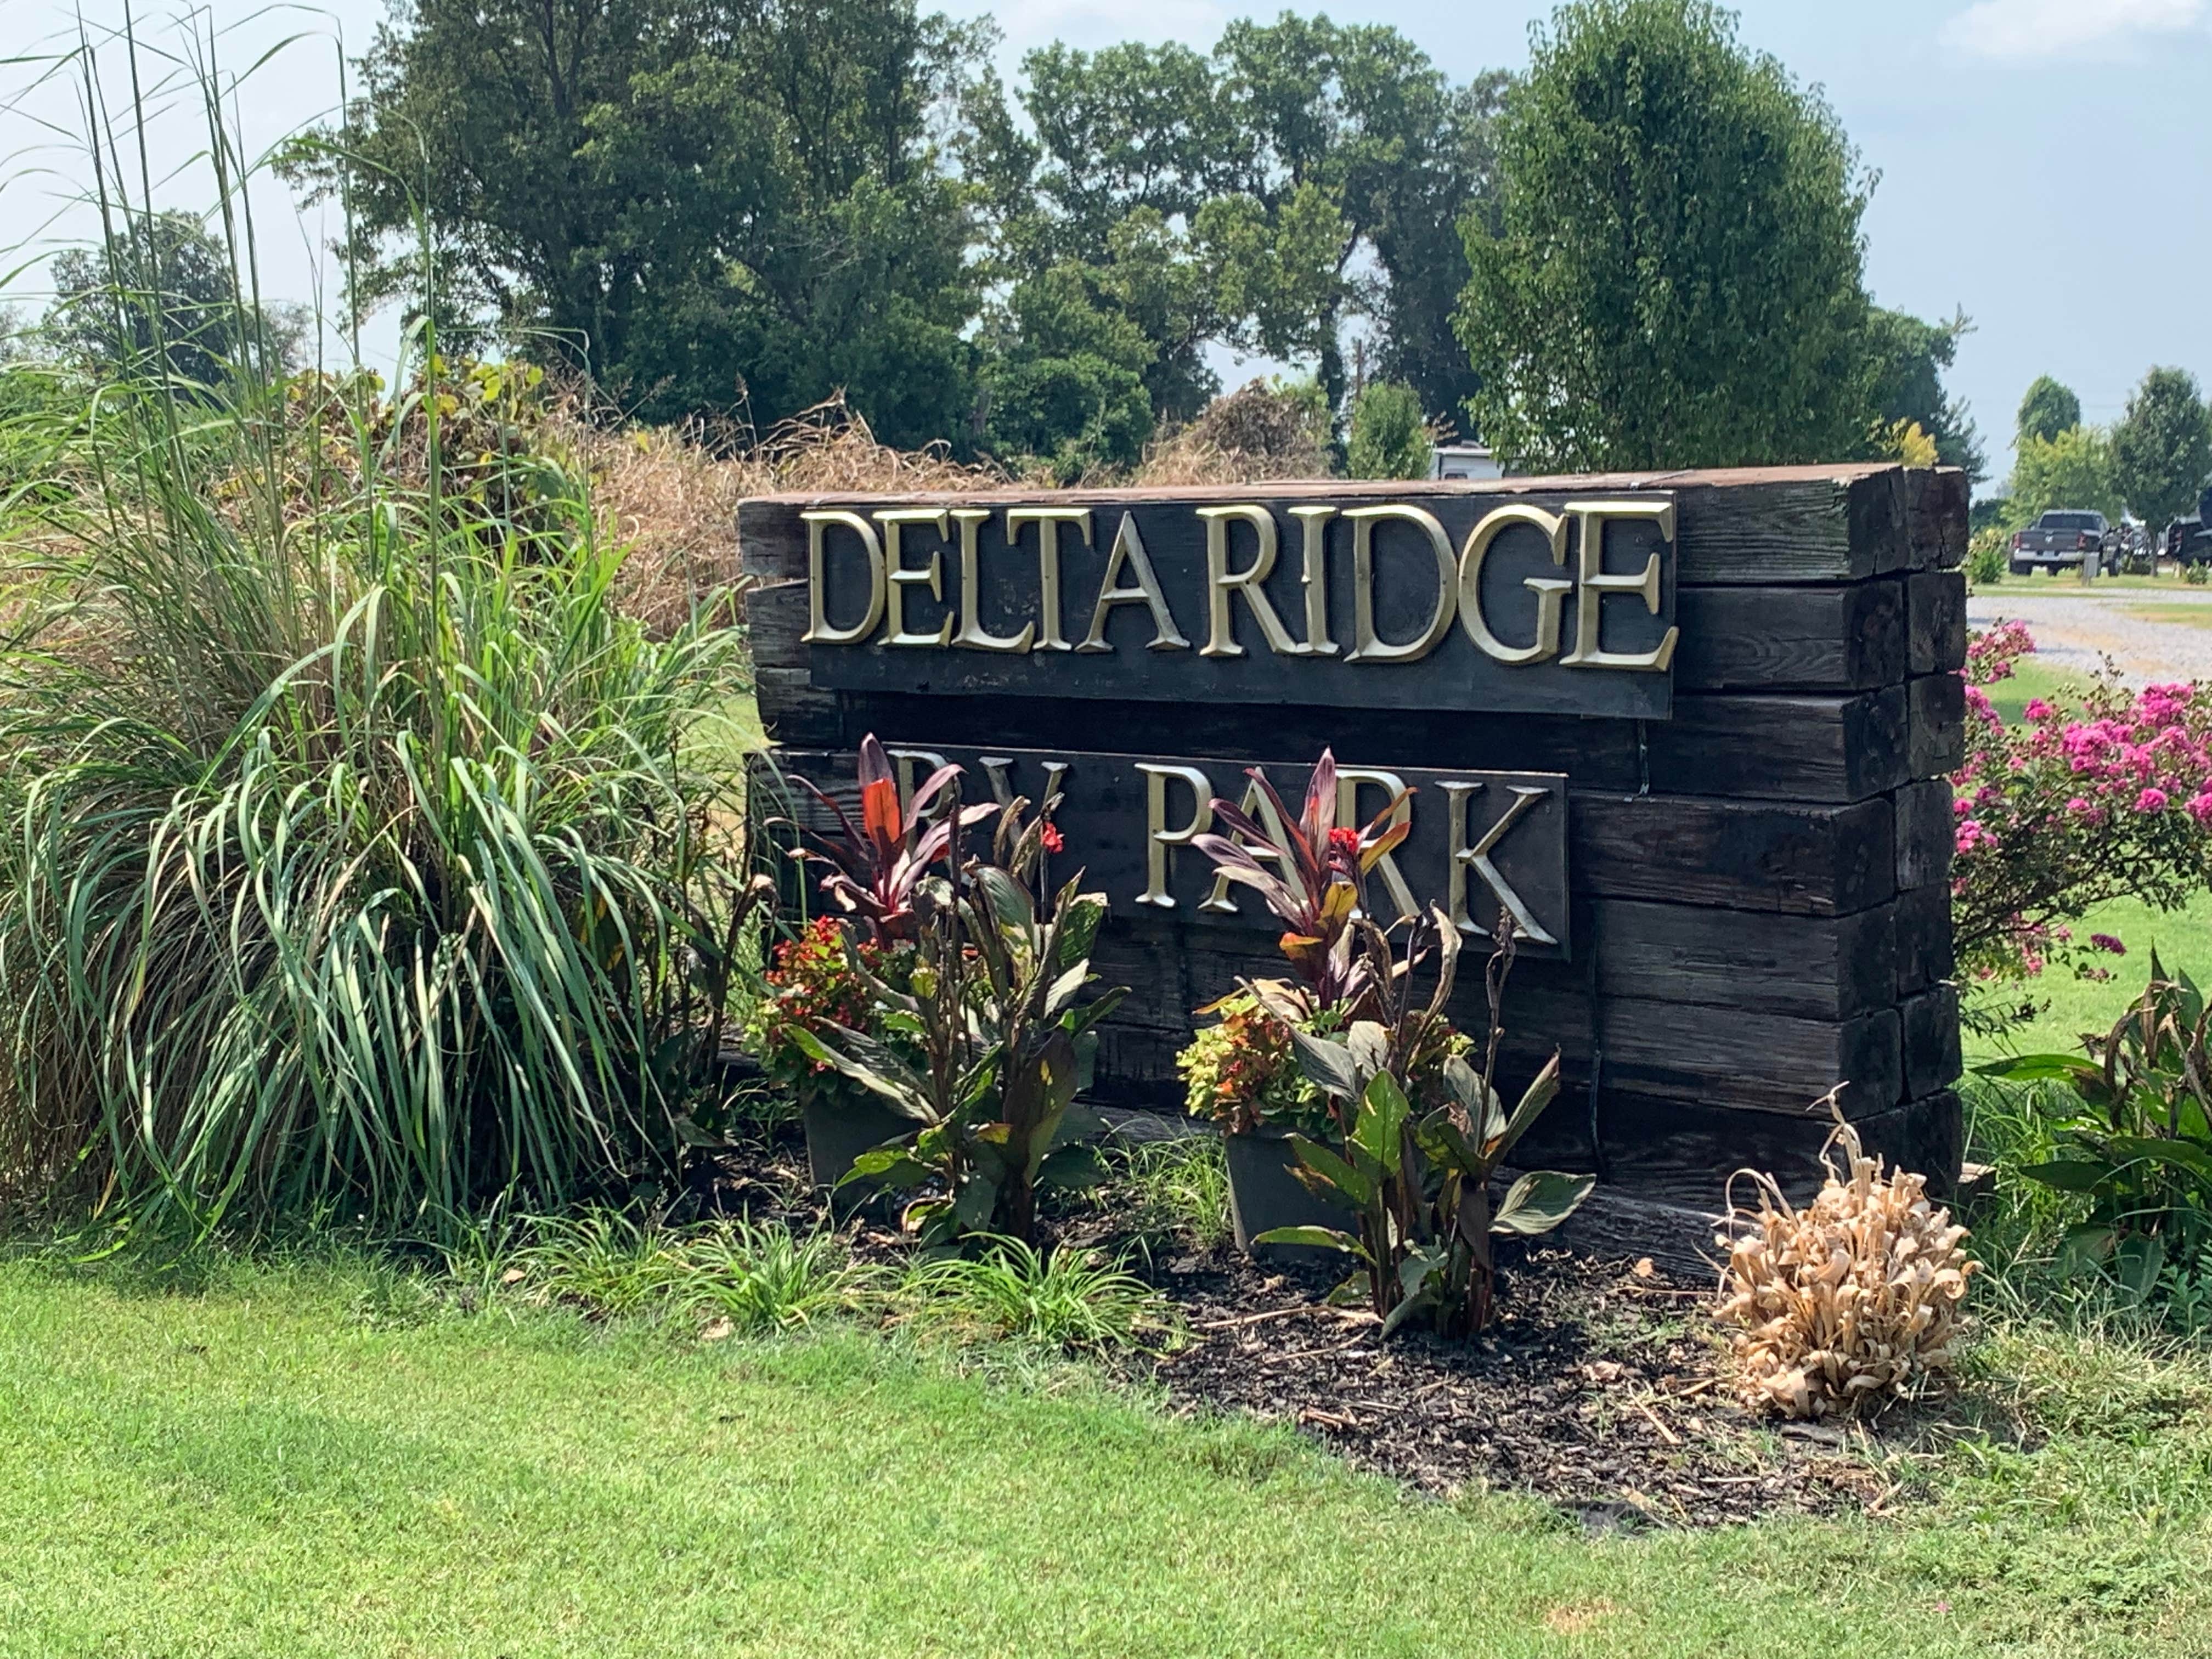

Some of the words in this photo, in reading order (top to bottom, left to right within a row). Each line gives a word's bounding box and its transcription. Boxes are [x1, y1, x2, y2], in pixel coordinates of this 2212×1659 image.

[799, 507, 1192, 654] DELTA
[1195, 501, 1680, 673] RIDGE
[1134, 762, 1559, 945] PARK
